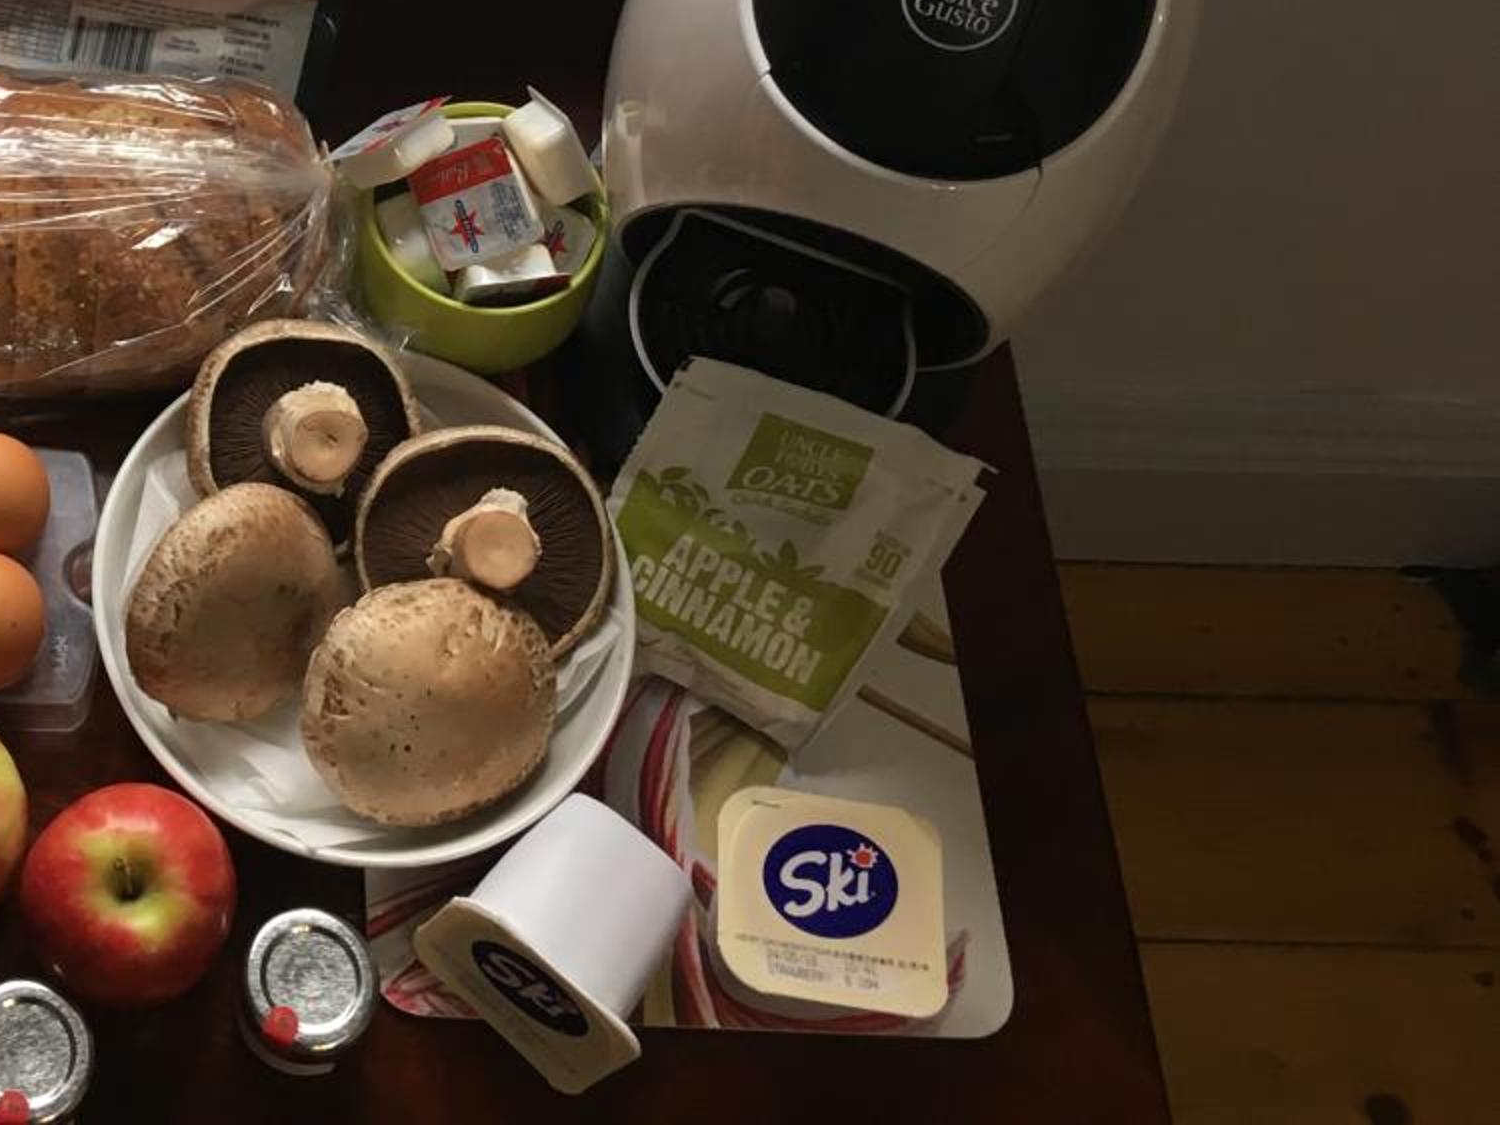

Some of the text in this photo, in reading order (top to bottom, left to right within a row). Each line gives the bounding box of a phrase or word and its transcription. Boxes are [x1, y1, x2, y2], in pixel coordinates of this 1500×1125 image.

[742, 466, 843, 505] OATS
[632, 554, 822, 685] CINNAMON
[663, 535, 816, 635] APPLE &
[780, 846, 873, 917] Ski
